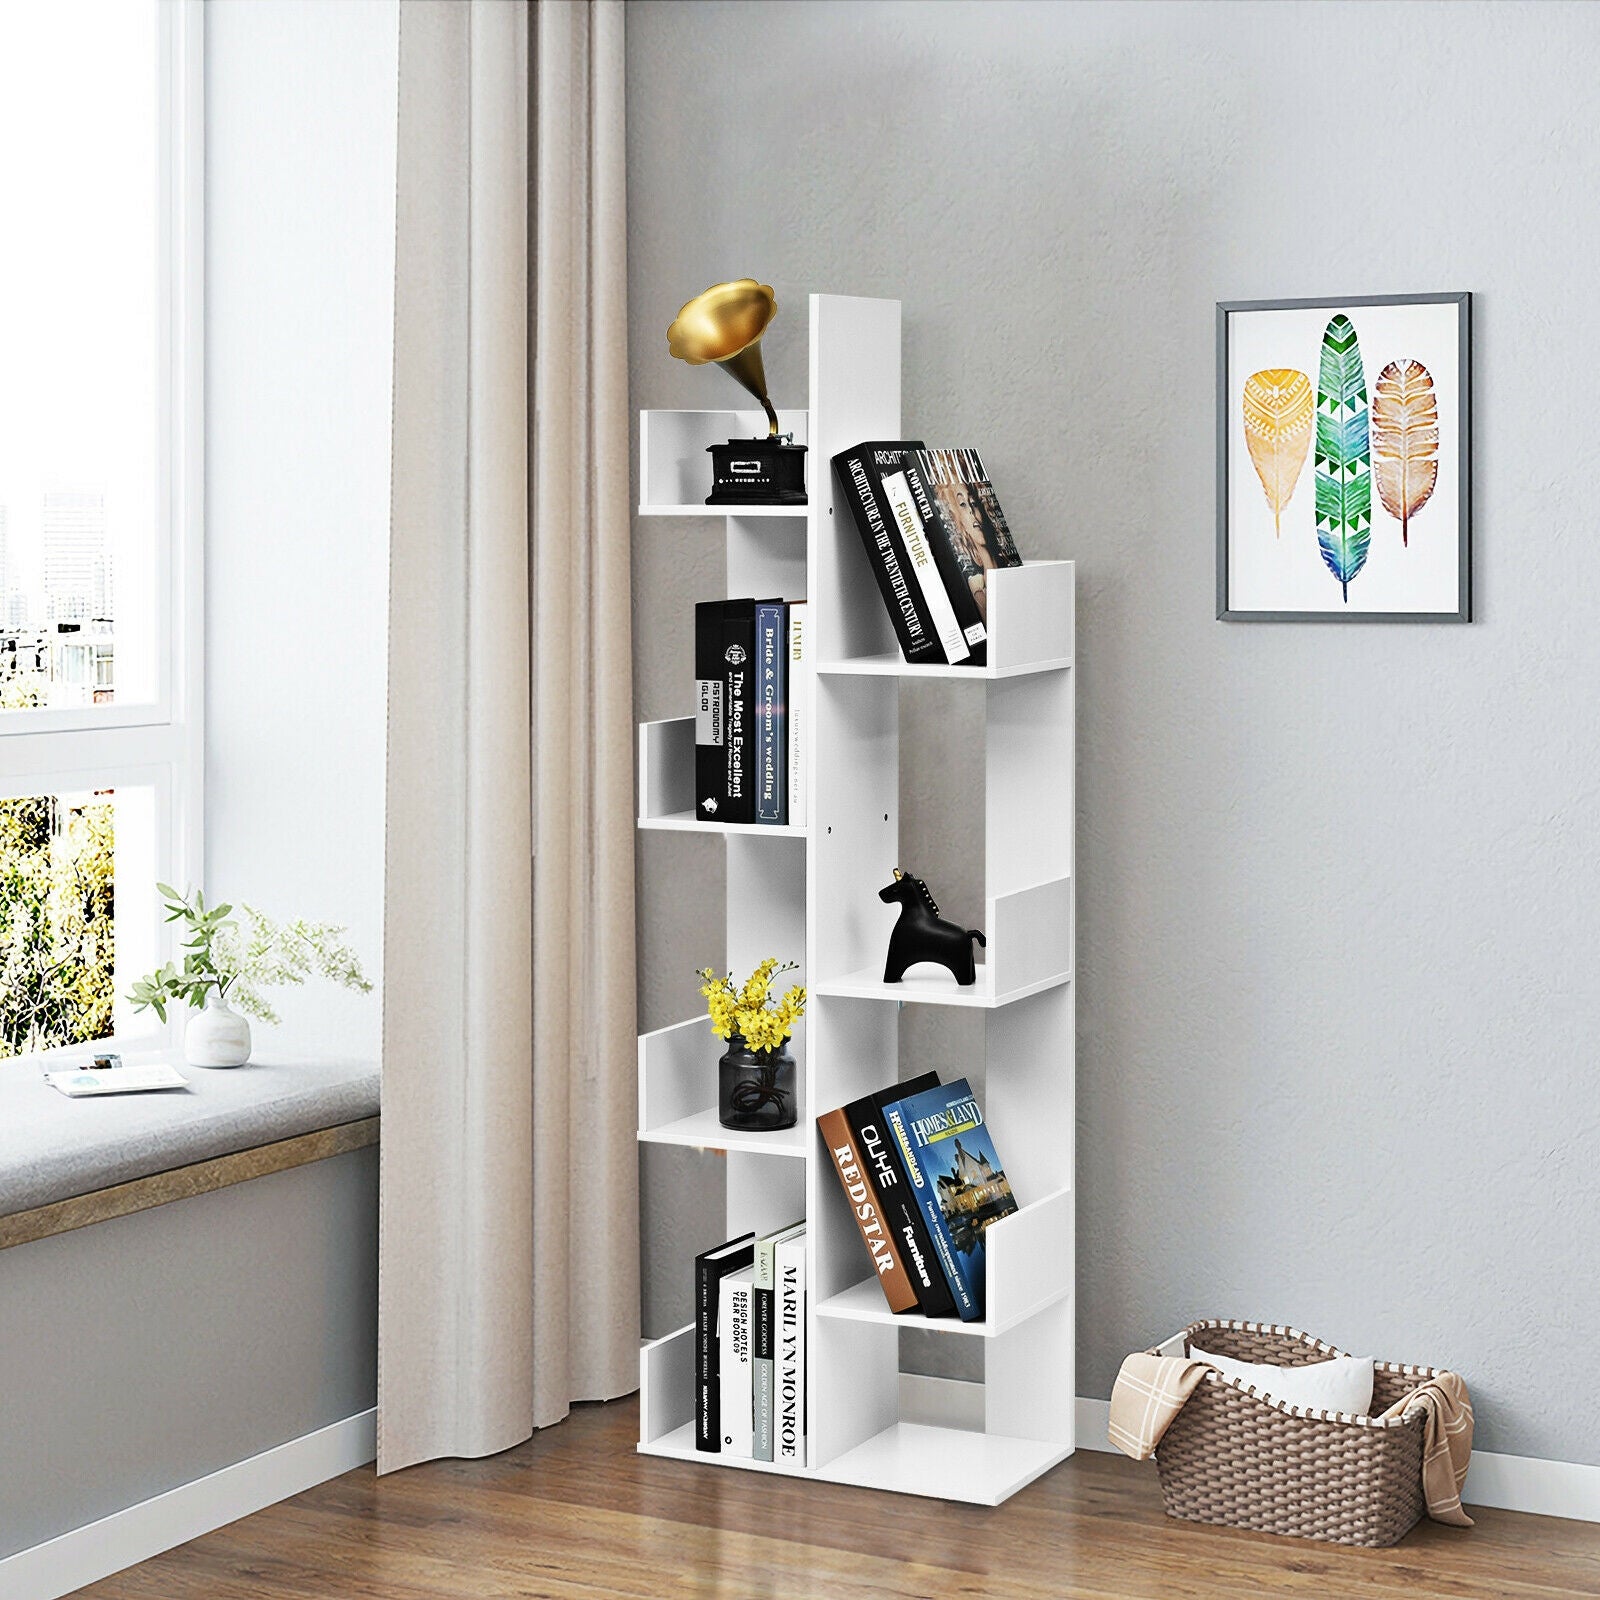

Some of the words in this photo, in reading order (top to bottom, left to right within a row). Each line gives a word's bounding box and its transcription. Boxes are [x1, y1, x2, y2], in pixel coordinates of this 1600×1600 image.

[874, 529, 891, 550] THE
[895, 501, 928, 568] FURNITURE
[881, 547, 909, 599] TWENTIETH
[793, 621, 802, 661] LUXURY
[898, 597, 923, 638] CENTURY
[765, 628, 774, 665] Bride
[701, 682, 709, 712] IGLOO
[734, 671, 744, 697] The
[765, 667, 774, 681] &
[712, 682, 720, 744] ASTRONOMY
[734, 700, 744, 733] Most
[765, 684, 775, 743] Groom's
[732, 736, 744, 798] Excellent
[763, 746, 774, 800] wedding
[834, 1143, 895, 1276] REDSTAR
[902, 1225, 932, 1288] Furniture
[926, 1200, 938, 1222] Family
[954, 1275, 964, 1291] since
[740, 1291, 748, 1325] DESIGN
[783, 1265, 797, 1363] MARILYN
[740, 1327, 748, 1363] HOTELS
[782, 1366, 797, 1457] MONROE
